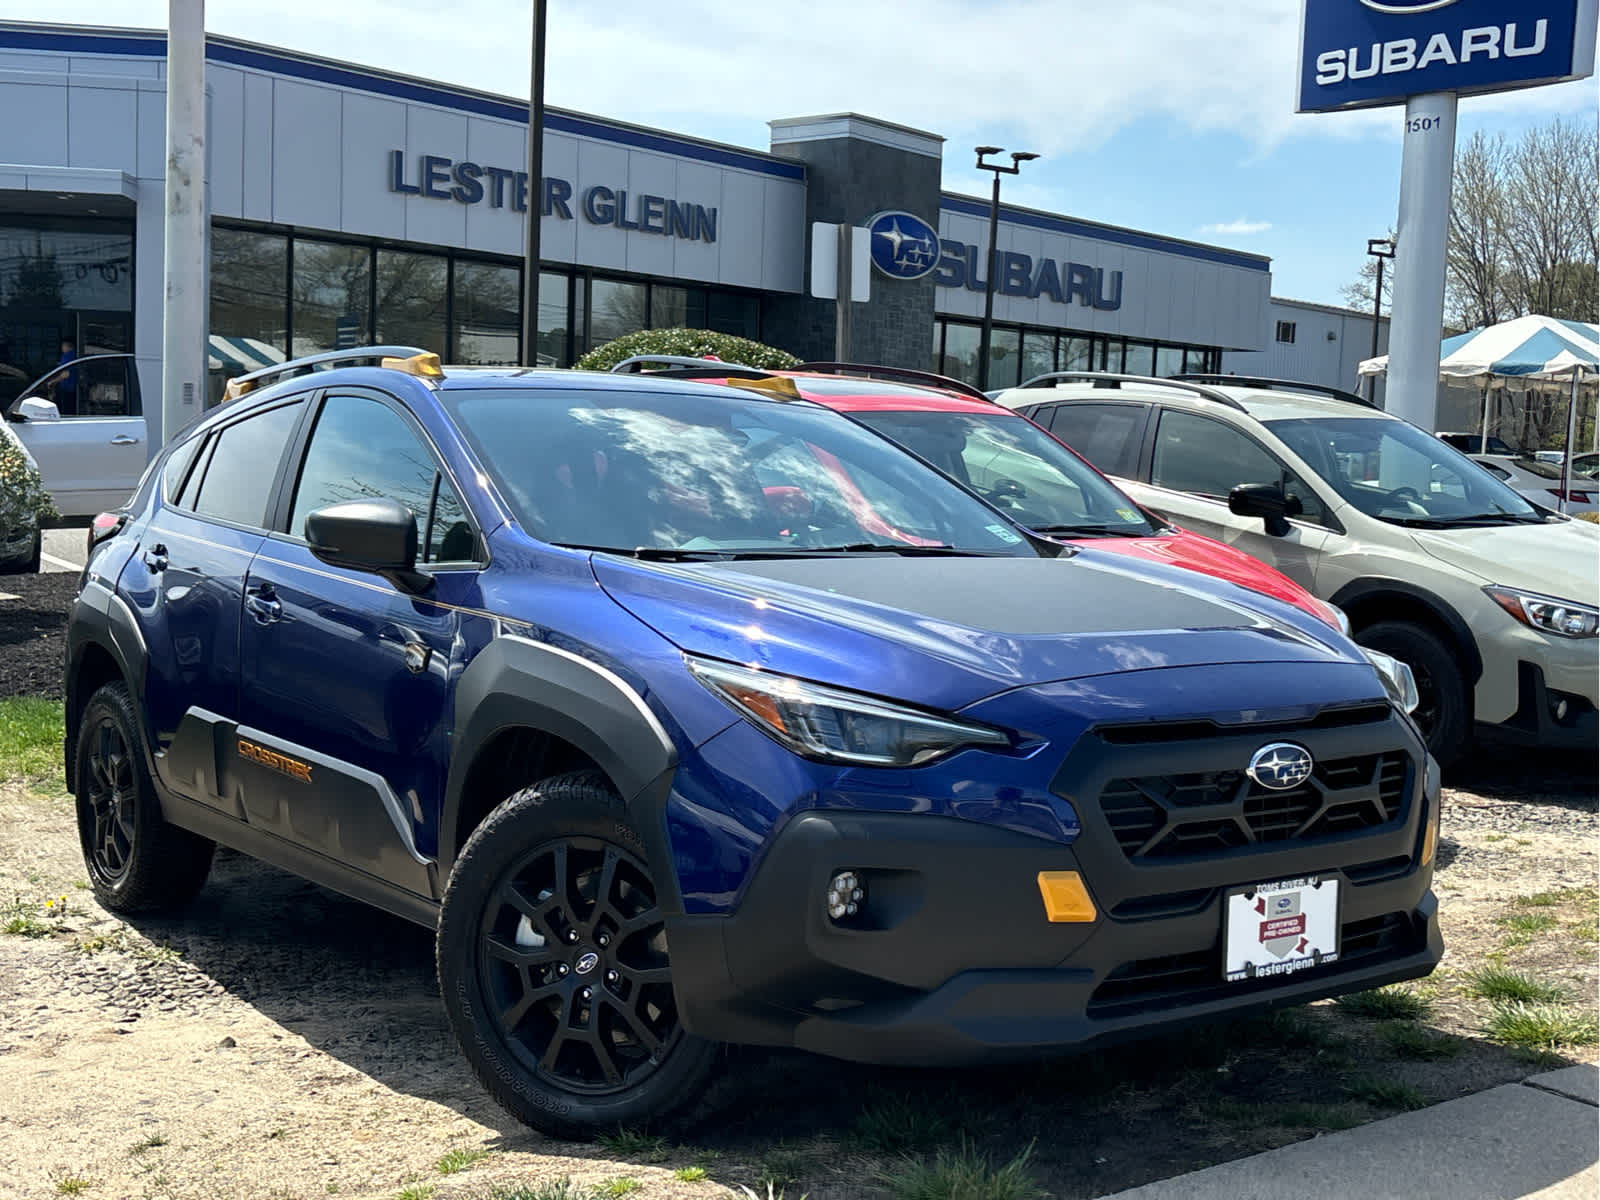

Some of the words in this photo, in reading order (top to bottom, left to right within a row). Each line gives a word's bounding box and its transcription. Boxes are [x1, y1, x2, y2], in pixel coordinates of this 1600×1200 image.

[1315, 18, 1548, 86] SUBARU
[1406, 116, 1441, 134] 1501
[584, 185, 718, 244] GLENN
[934, 238, 1124, 312] SUBARU
[237, 740, 313, 784] CROSSTREK
[1267, 919, 1299, 930] CERTIFIED
[1255, 958, 1314, 978] lesterglenn
